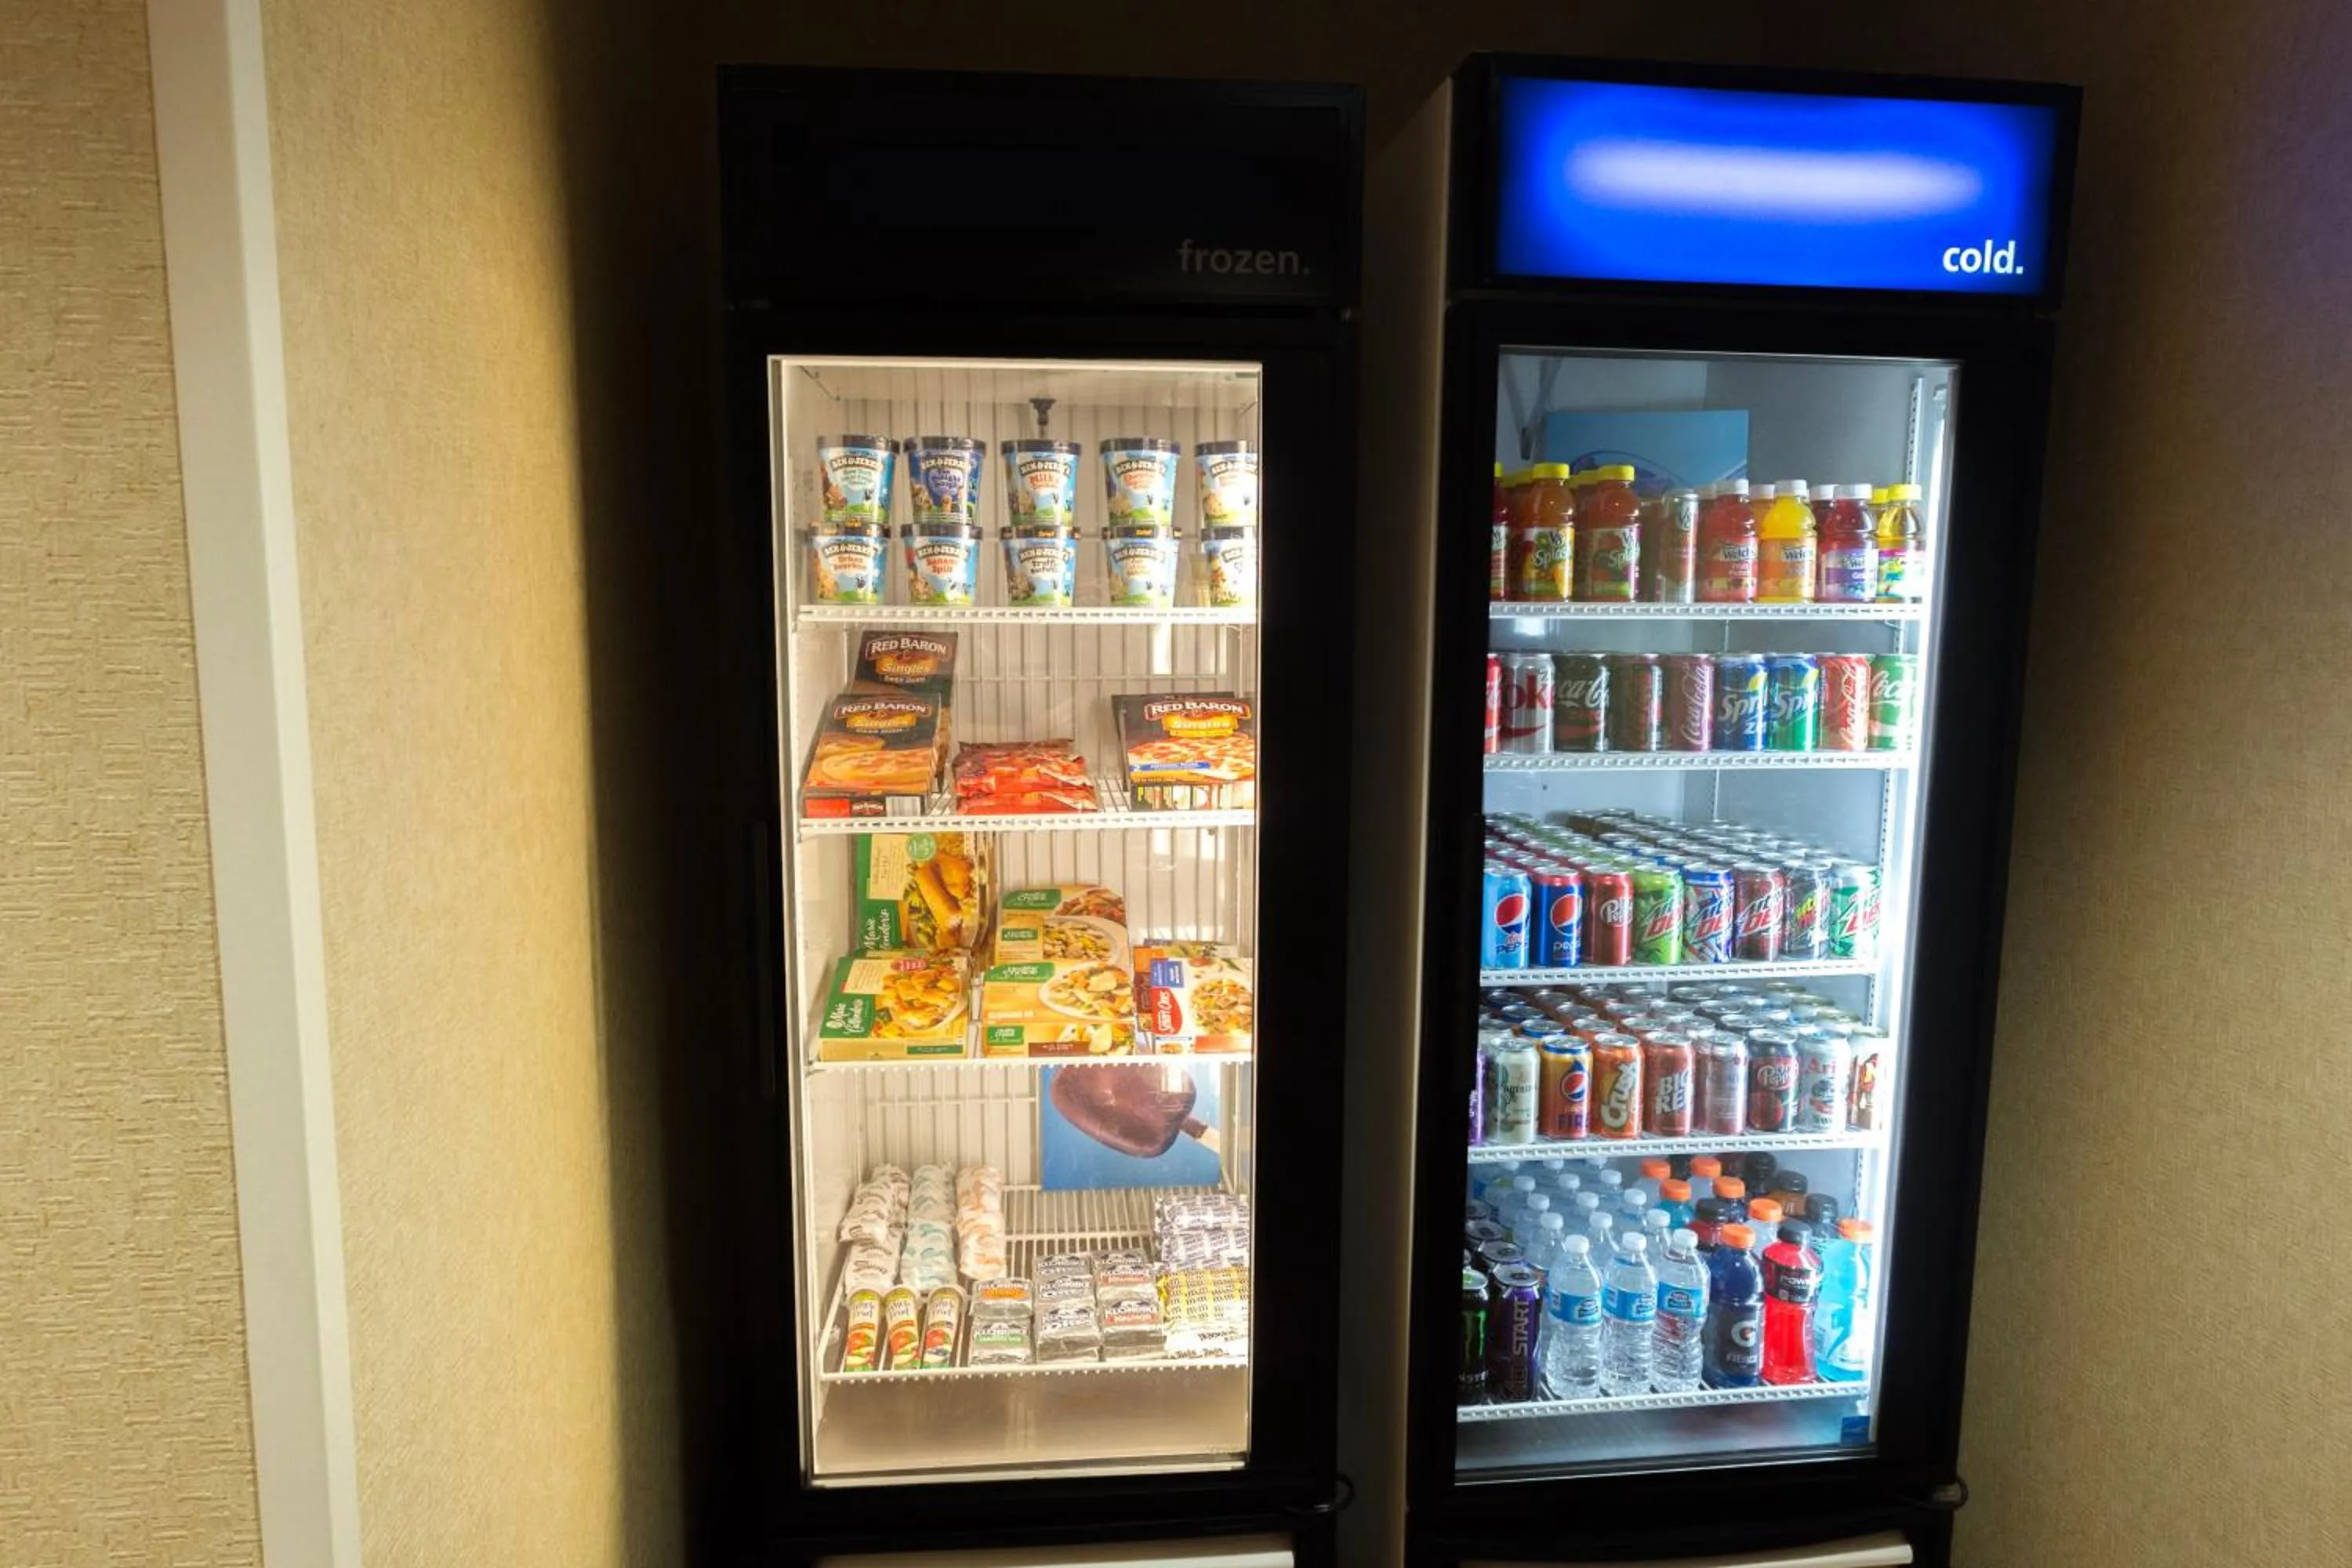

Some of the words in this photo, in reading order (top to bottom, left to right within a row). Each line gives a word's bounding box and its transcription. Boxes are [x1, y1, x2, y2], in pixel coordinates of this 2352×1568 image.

[1178, 238, 1309, 275] frozen.
[1942, 238, 2024, 275] cold.
[871, 640, 899, 654] RED
[900, 637, 947, 655] BARON
[841, 704, 872, 715] RED
[873, 702, 927, 713] BARON
[1150, 704, 1183, 716] RED
[1185, 701, 1244, 714] BARON
[1655, 1087, 1691, 1114] RE
[1513, 1296, 1530, 1356] START
